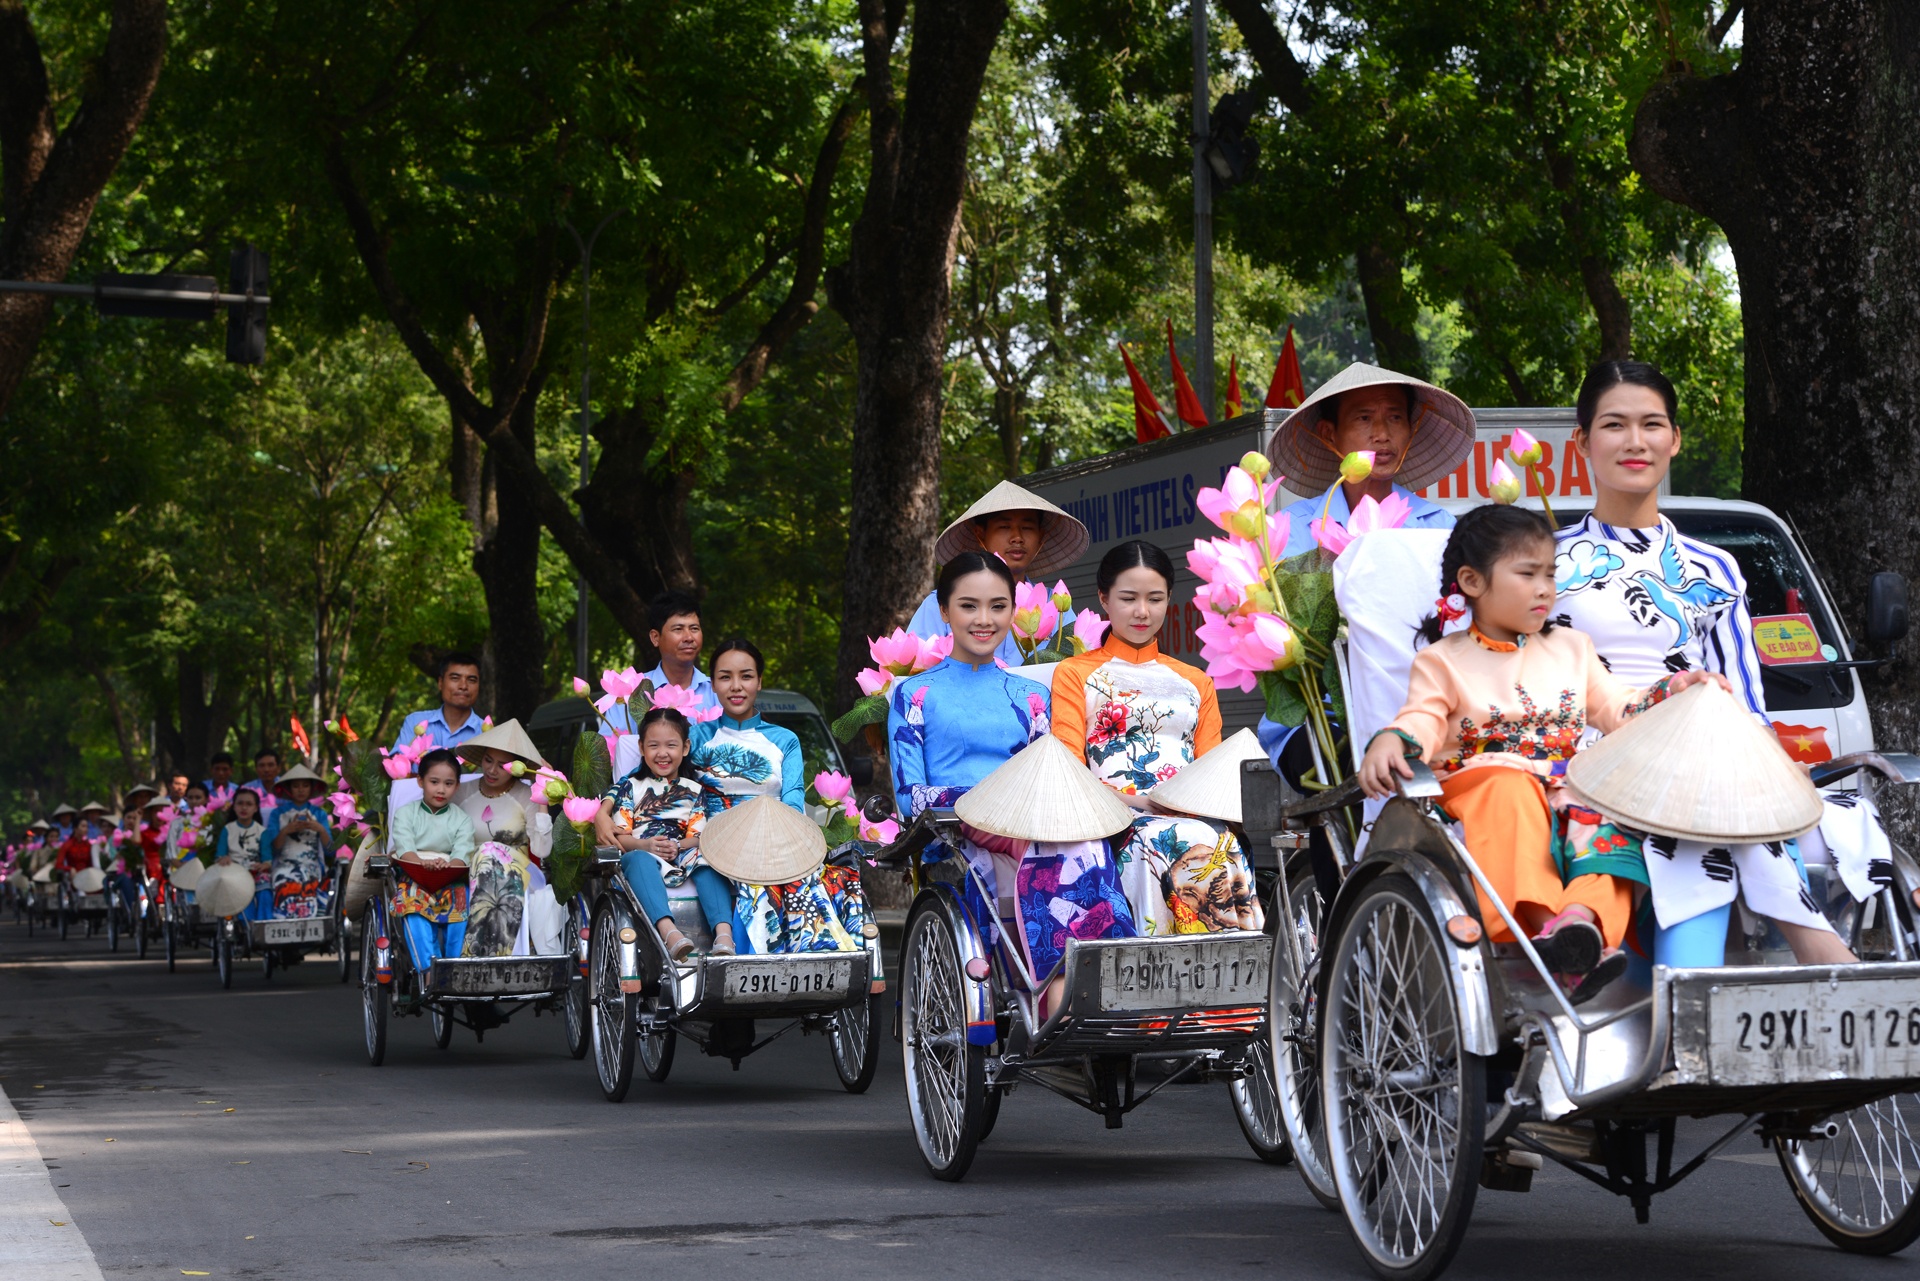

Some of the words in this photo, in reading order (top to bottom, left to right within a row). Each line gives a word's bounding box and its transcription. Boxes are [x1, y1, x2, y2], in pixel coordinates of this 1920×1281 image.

[1414, 435, 1512, 499] HƯ
[1060, 489, 1109, 543] ÍNH
[1113, 473, 1196, 539] VIETTELS
[1766, 643, 1778, 654] XE
[737, 971, 836, 993] 29XL-0184
[1736, 1007, 1920, 1053] 29XL-0126
